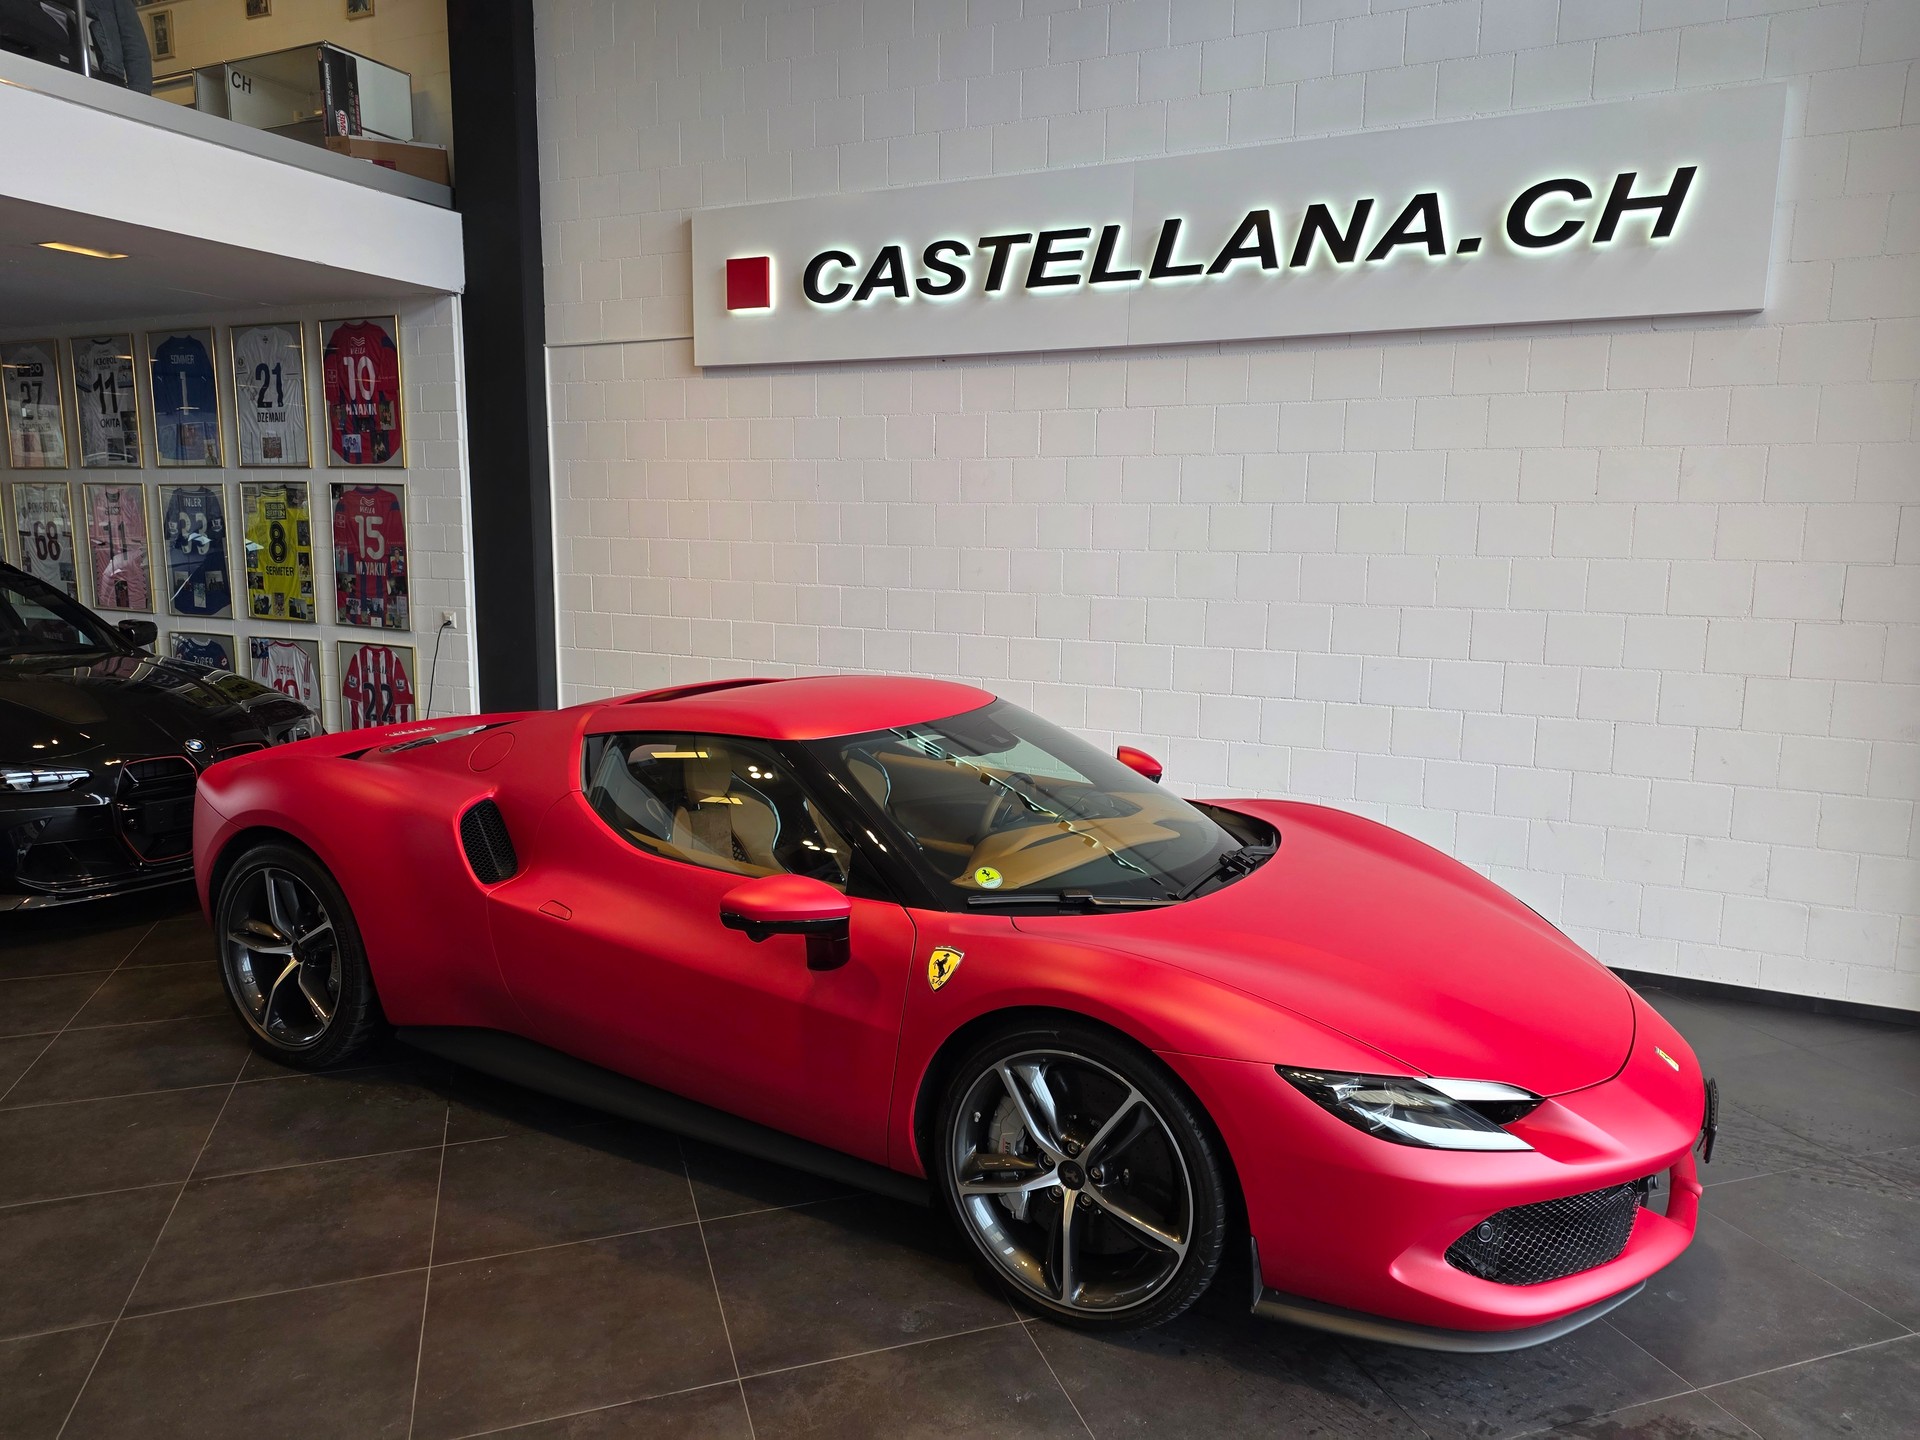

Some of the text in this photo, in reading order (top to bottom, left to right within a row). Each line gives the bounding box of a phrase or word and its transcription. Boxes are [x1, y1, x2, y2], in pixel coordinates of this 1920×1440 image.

[231, 71, 251, 94] CH
[339, 113, 347, 137] BMC
[802, 165, 1699, 304] CASTELLANA.CH
[170, 354, 195, 365] SOMMER
[343, 355, 376, 401] 10
[20, 380, 43, 421] 27
[92, 371, 119, 415] 11
[180, 371, 189, 416] 1
[254, 362, 285, 409] 21
[100, 418, 121, 429] OKITA
[256, 411, 286, 423] DZEMAILI
[183, 497, 202, 508] INLER
[33, 520, 61, 561] 68
[179, 512, 210, 555] 33
[269, 520, 288, 564] 8
[354, 515, 386, 560] 15
[265, 565, 295, 577] SERMETER
[363, 682, 395, 723] 22
